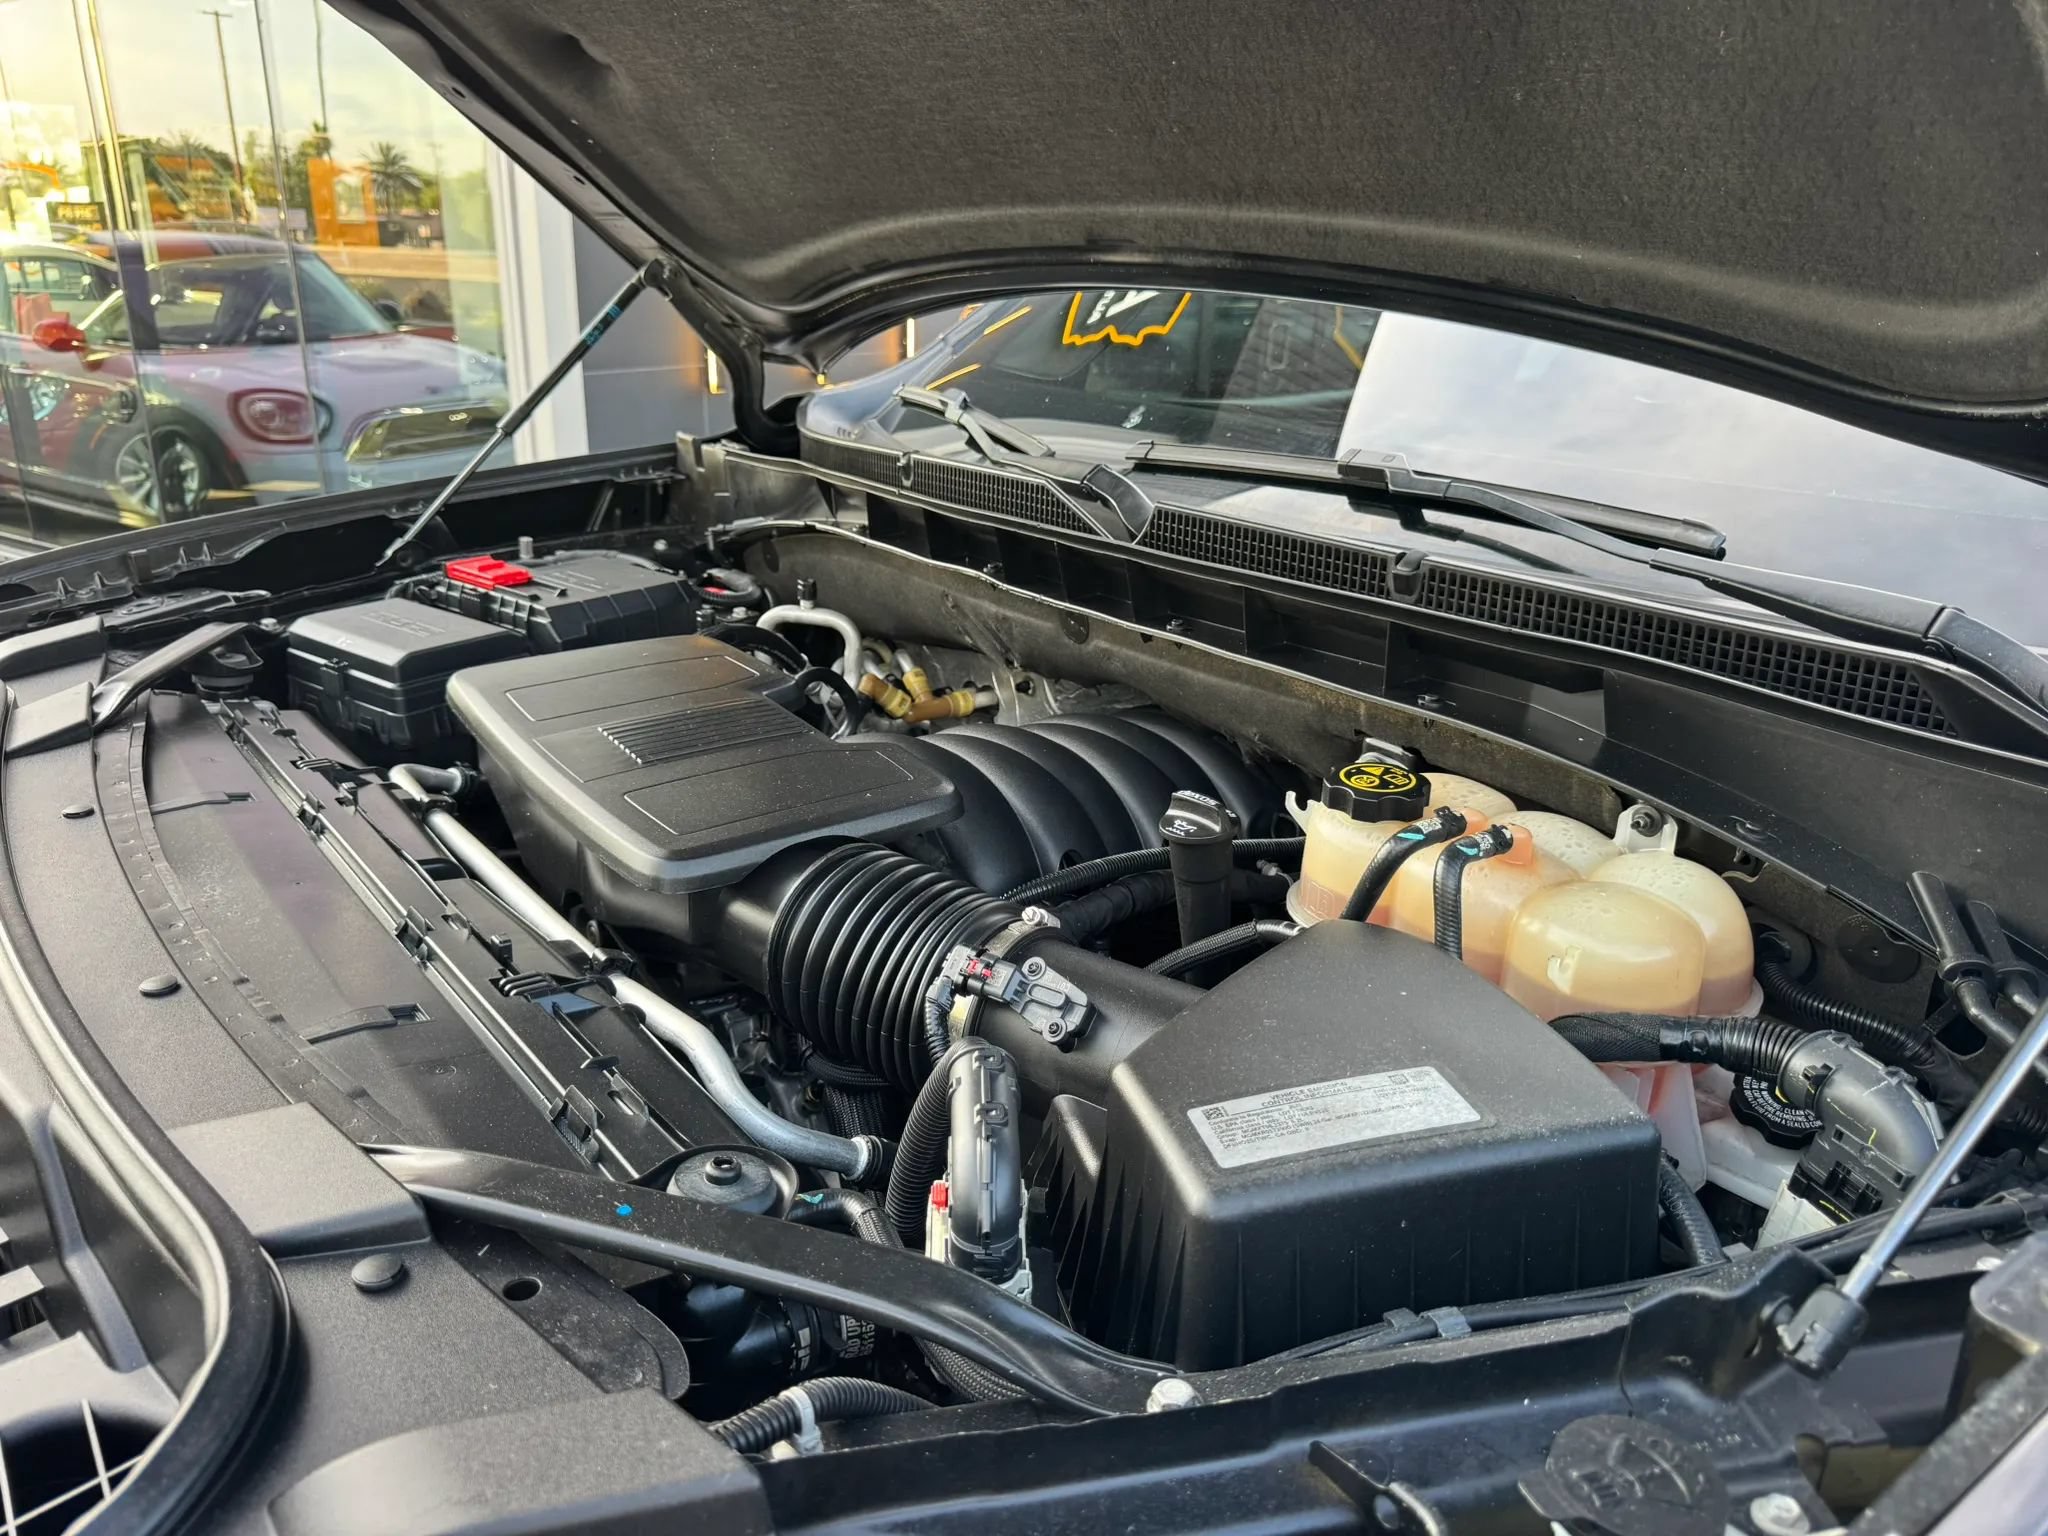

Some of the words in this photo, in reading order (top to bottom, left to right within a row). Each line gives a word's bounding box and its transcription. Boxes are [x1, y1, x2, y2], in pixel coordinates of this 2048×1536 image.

[1784, 1107, 1805, 1116] CLEAN
[1764, 1111, 1781, 1123] FROM
[1786, 1120, 1810, 1129] SEALED
